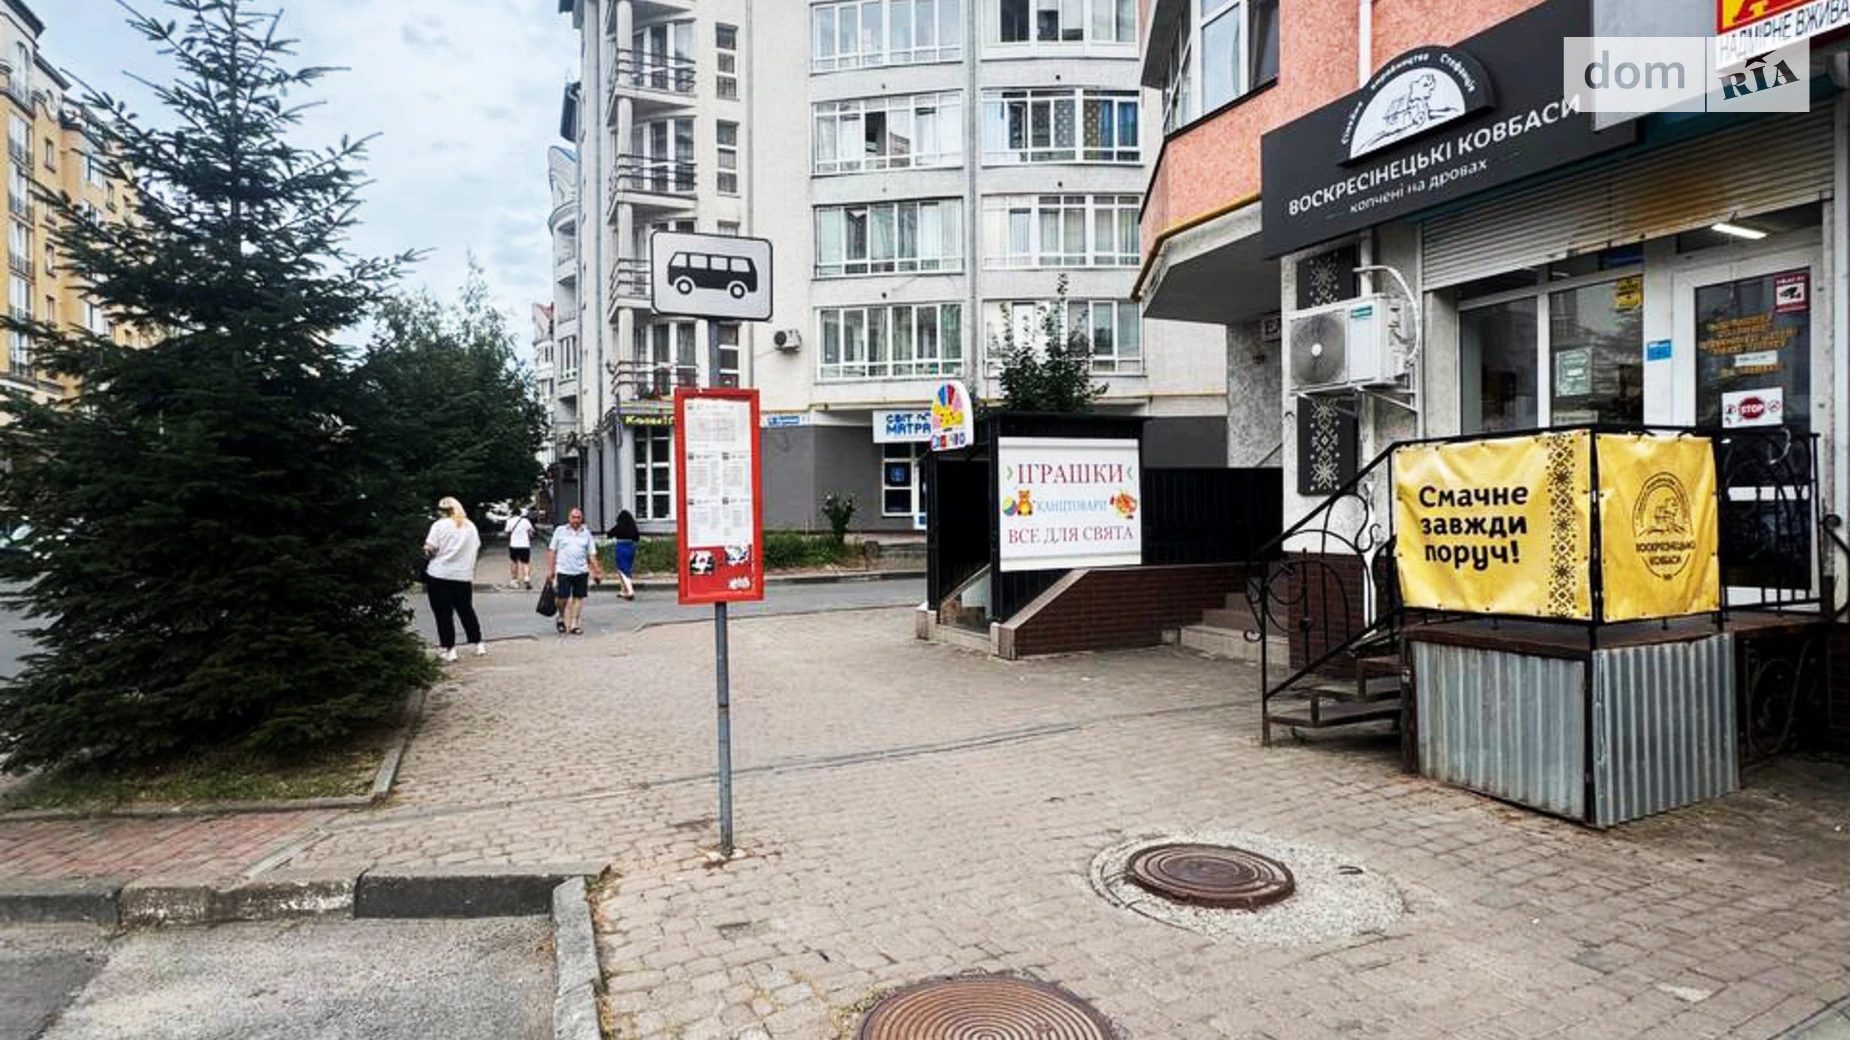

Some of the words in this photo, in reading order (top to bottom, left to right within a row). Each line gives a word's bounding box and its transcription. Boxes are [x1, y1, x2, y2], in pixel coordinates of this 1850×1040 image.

[1288, 141, 1453, 216] ВОСКРЕСІНЕЦЬКІ
[1457, 93, 1581, 156] КОВБАСИ
[1350, 183, 1405, 213] копчені
[1407, 180, 1426, 194] на
[1428, 159, 1488, 192] дровах
[1740, 403, 1766, 414] STOP
[1017, 463, 1124, 484] ІГРАШКИ
[1036, 498, 1107, 513] КАНЦТОВАРИ
[1418, 485, 1529, 508] Смачне
[1008, 528, 1040, 544] ВСЕ
[1043, 526, 1079, 544] ДЛЯ
[1082, 525, 1134, 542] СВЯТА
[1420, 514, 1527, 538] завжди
[1425, 540, 1520, 571] поруч!
